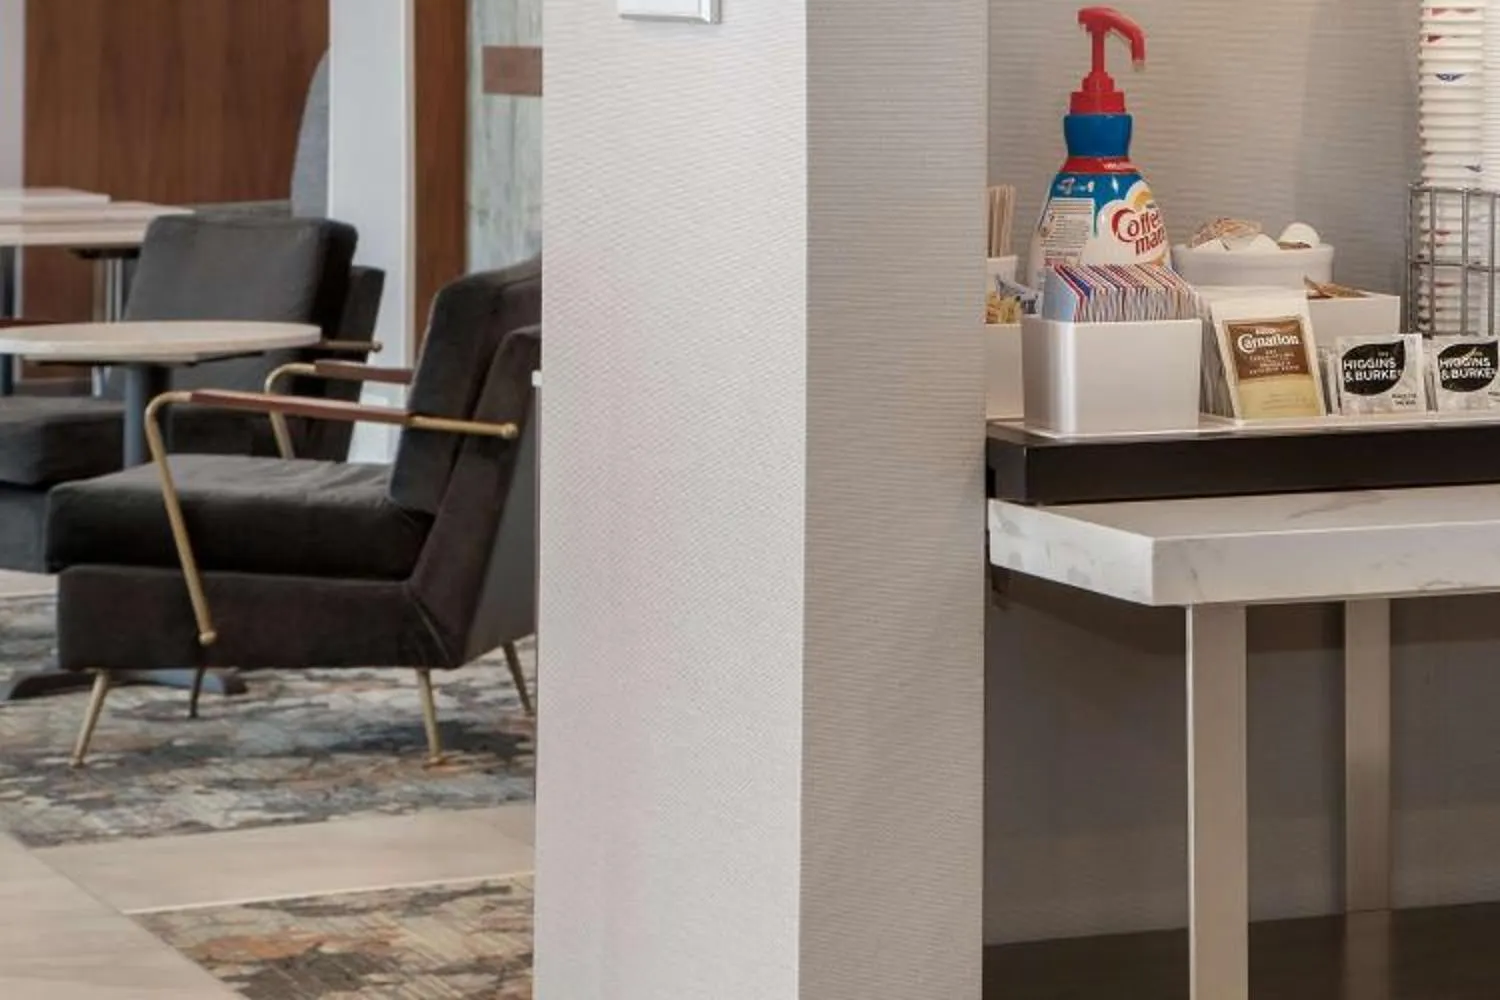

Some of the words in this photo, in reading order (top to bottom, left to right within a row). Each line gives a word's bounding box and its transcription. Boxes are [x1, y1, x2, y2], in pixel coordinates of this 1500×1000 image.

[1237, 332, 1299, 354] Carnation
[1343, 357, 1397, 370] HIGGINS
[1439, 357, 1491, 369] HIGGINS
[1344, 371, 1353, 383] &
[1355, 369, 1398, 381] BURKE
[1441, 369, 1450, 380] &
[1451, 368, 1493, 379] BURKE
